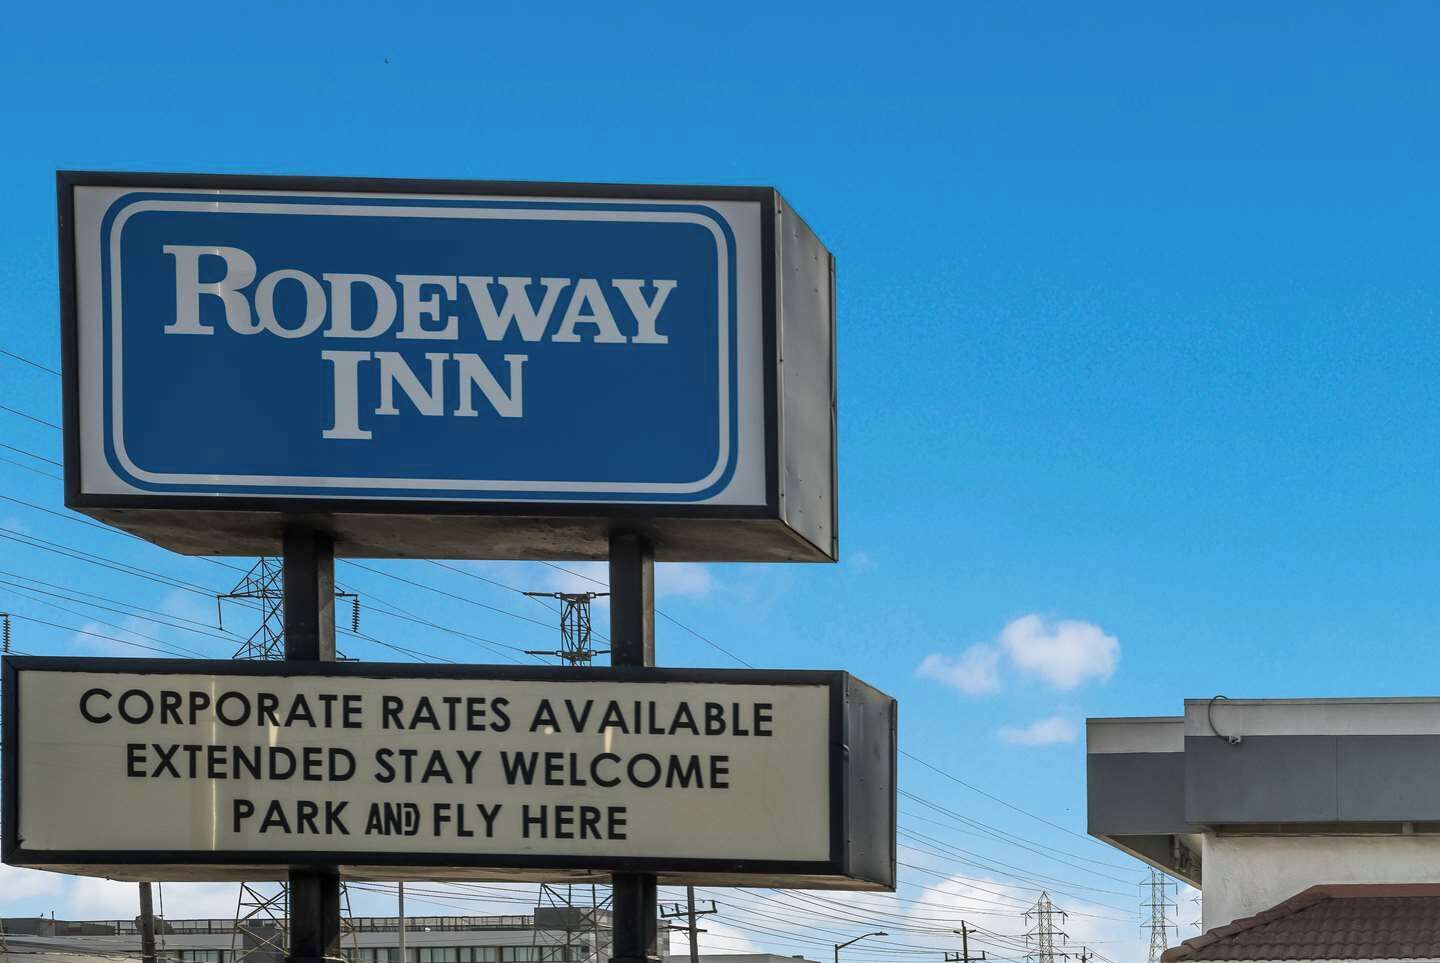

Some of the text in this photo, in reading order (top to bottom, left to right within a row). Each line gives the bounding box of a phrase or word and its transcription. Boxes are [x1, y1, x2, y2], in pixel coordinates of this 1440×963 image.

[163, 244, 677, 344] RODEWAY
[322, 350, 528, 439] INN
[79, 688, 774, 737] CORPORATE RATES AVAILABLE
[126, 743, 729, 789] EXTENDED STAY WELCOME
[233, 799, 627, 841] PARK AND FLY HERE
